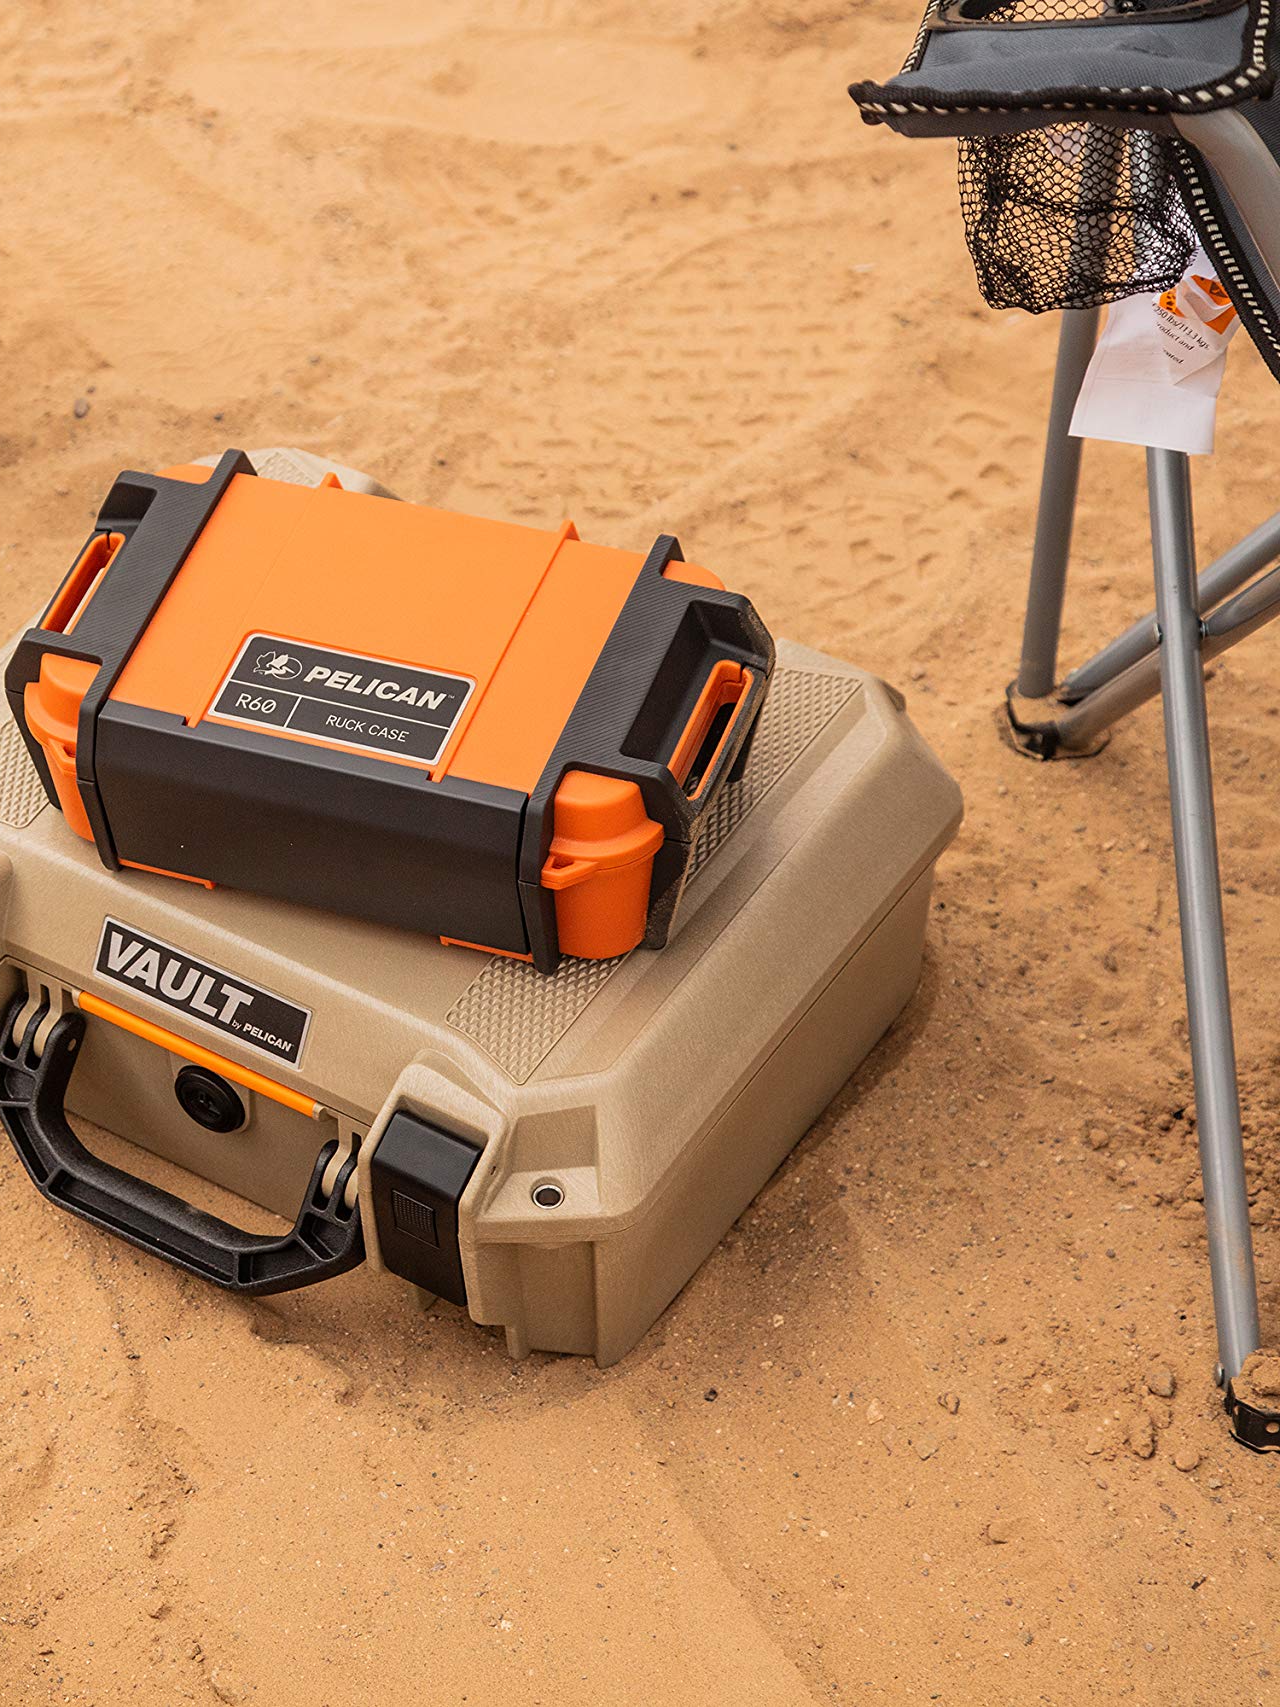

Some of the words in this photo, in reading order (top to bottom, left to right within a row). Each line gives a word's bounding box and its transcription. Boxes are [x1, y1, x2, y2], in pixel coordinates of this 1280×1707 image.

[234, 692, 277, 715] R60
[325, 714, 365, 734] RUCK
[369, 724, 410, 743] CASE
[107, 931, 255, 1025] VAULT
[231, 1020, 242, 1030] by
